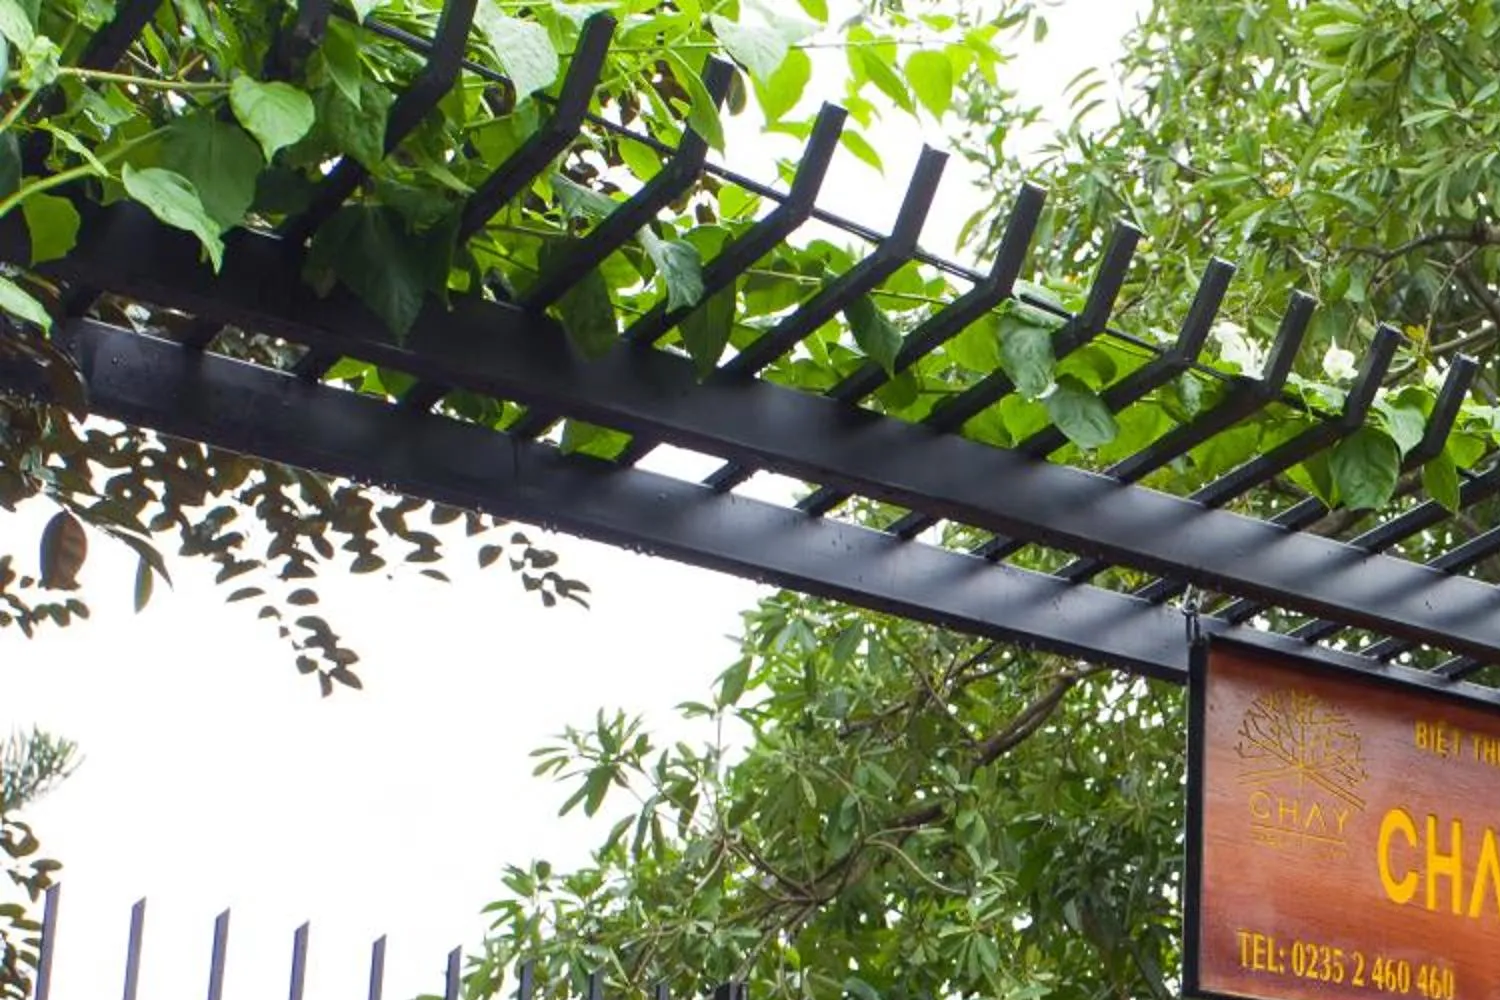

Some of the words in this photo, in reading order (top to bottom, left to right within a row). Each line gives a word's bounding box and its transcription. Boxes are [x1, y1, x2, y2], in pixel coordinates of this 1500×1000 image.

[1249, 790, 1352, 835] CHAY
[1236, 929, 1284, 974] TEL:
[1291, 940, 1345, 984] 0235
[1352, 952, 1366, 987] 2
[1371, 955, 1411, 994] 460
[1417, 963, 1456, 1000] 460
